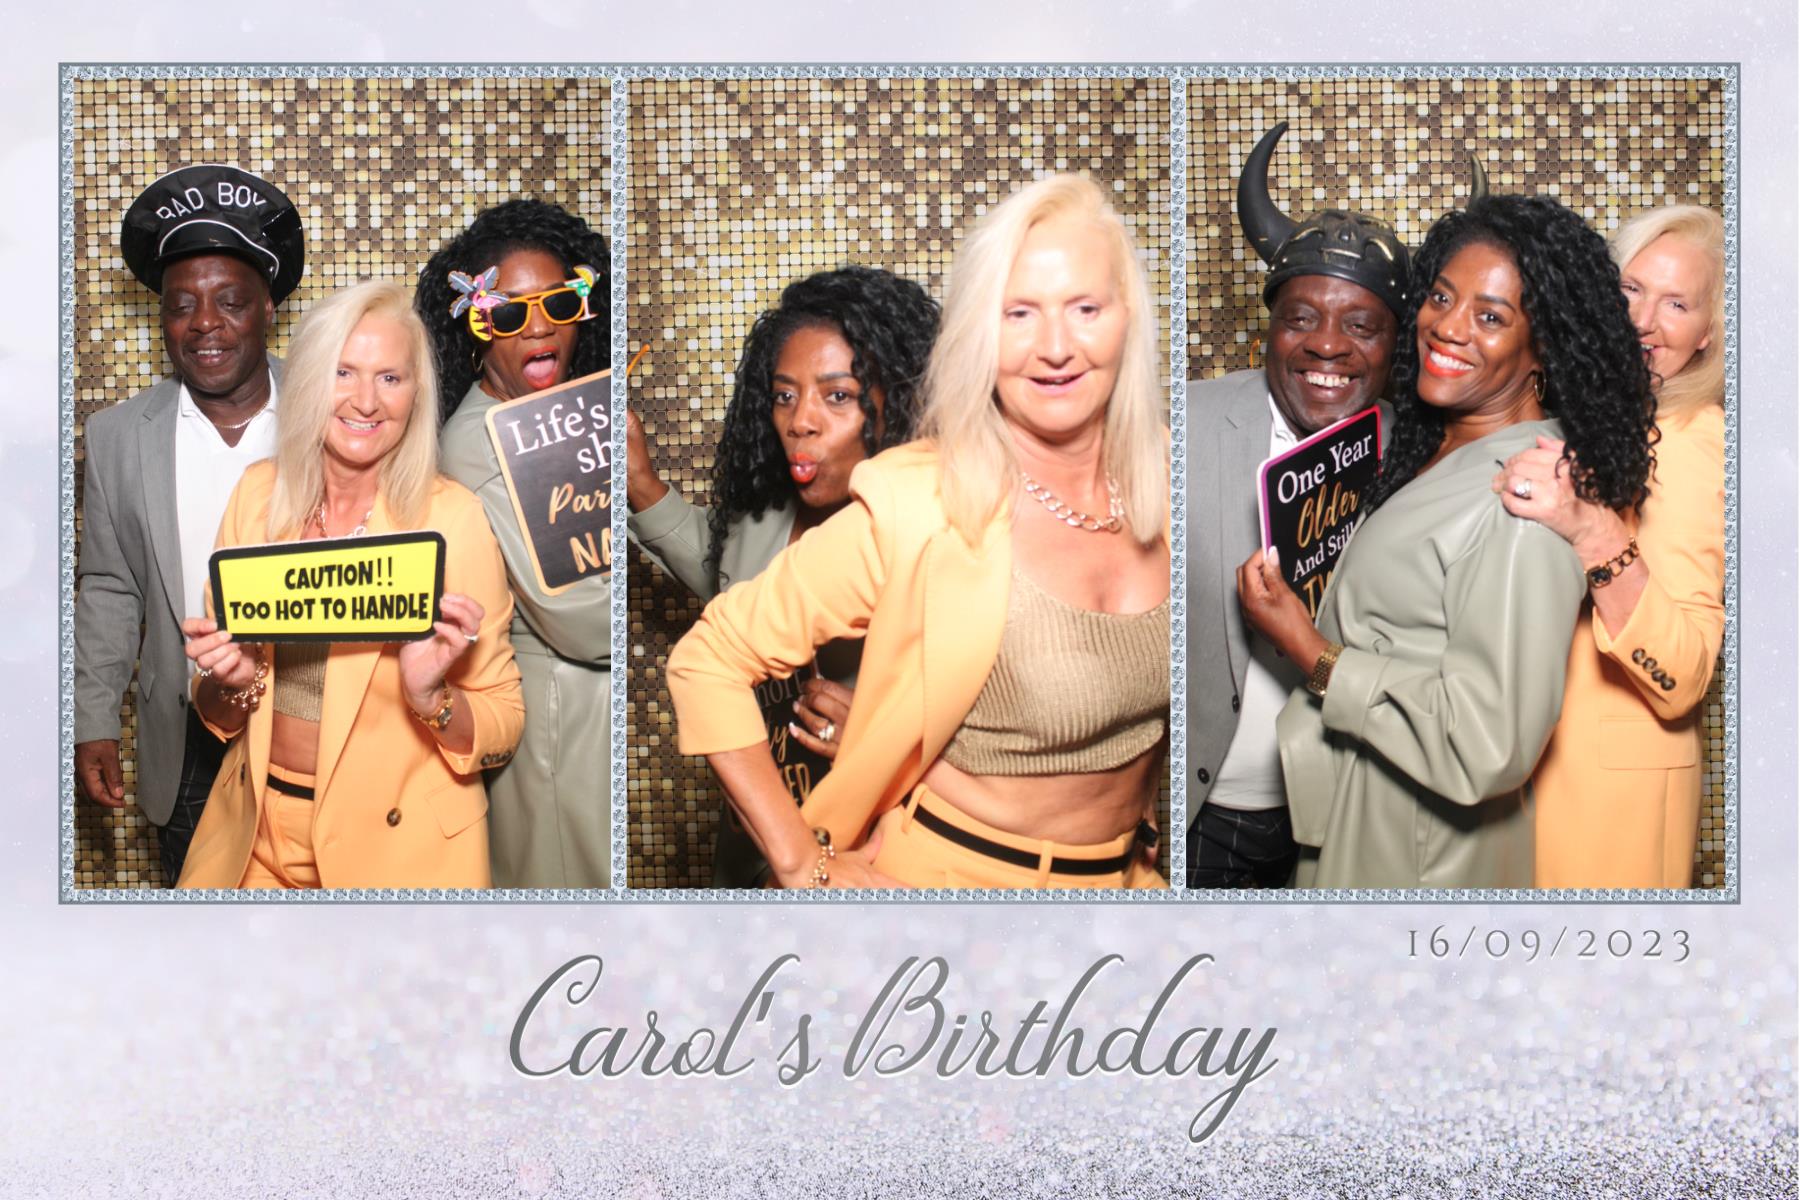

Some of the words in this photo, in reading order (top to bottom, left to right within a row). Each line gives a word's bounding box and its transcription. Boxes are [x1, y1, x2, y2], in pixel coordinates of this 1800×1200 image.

[506, 396, 609, 456] Life's
[1277, 462, 1326, 504] One
[1329, 434, 1372, 474] Year
[548, 480, 611, 525] Par
[1297, 480, 1360, 548] Older
[284, 556, 393, 590] CAUTION!!
[1293, 542, 1325, 583] And
[230, 601, 271, 620] TOO
[275, 598, 316, 620] HOT
[320, 597, 347, 620] TO
[351, 592, 429, 621] HANDLE
